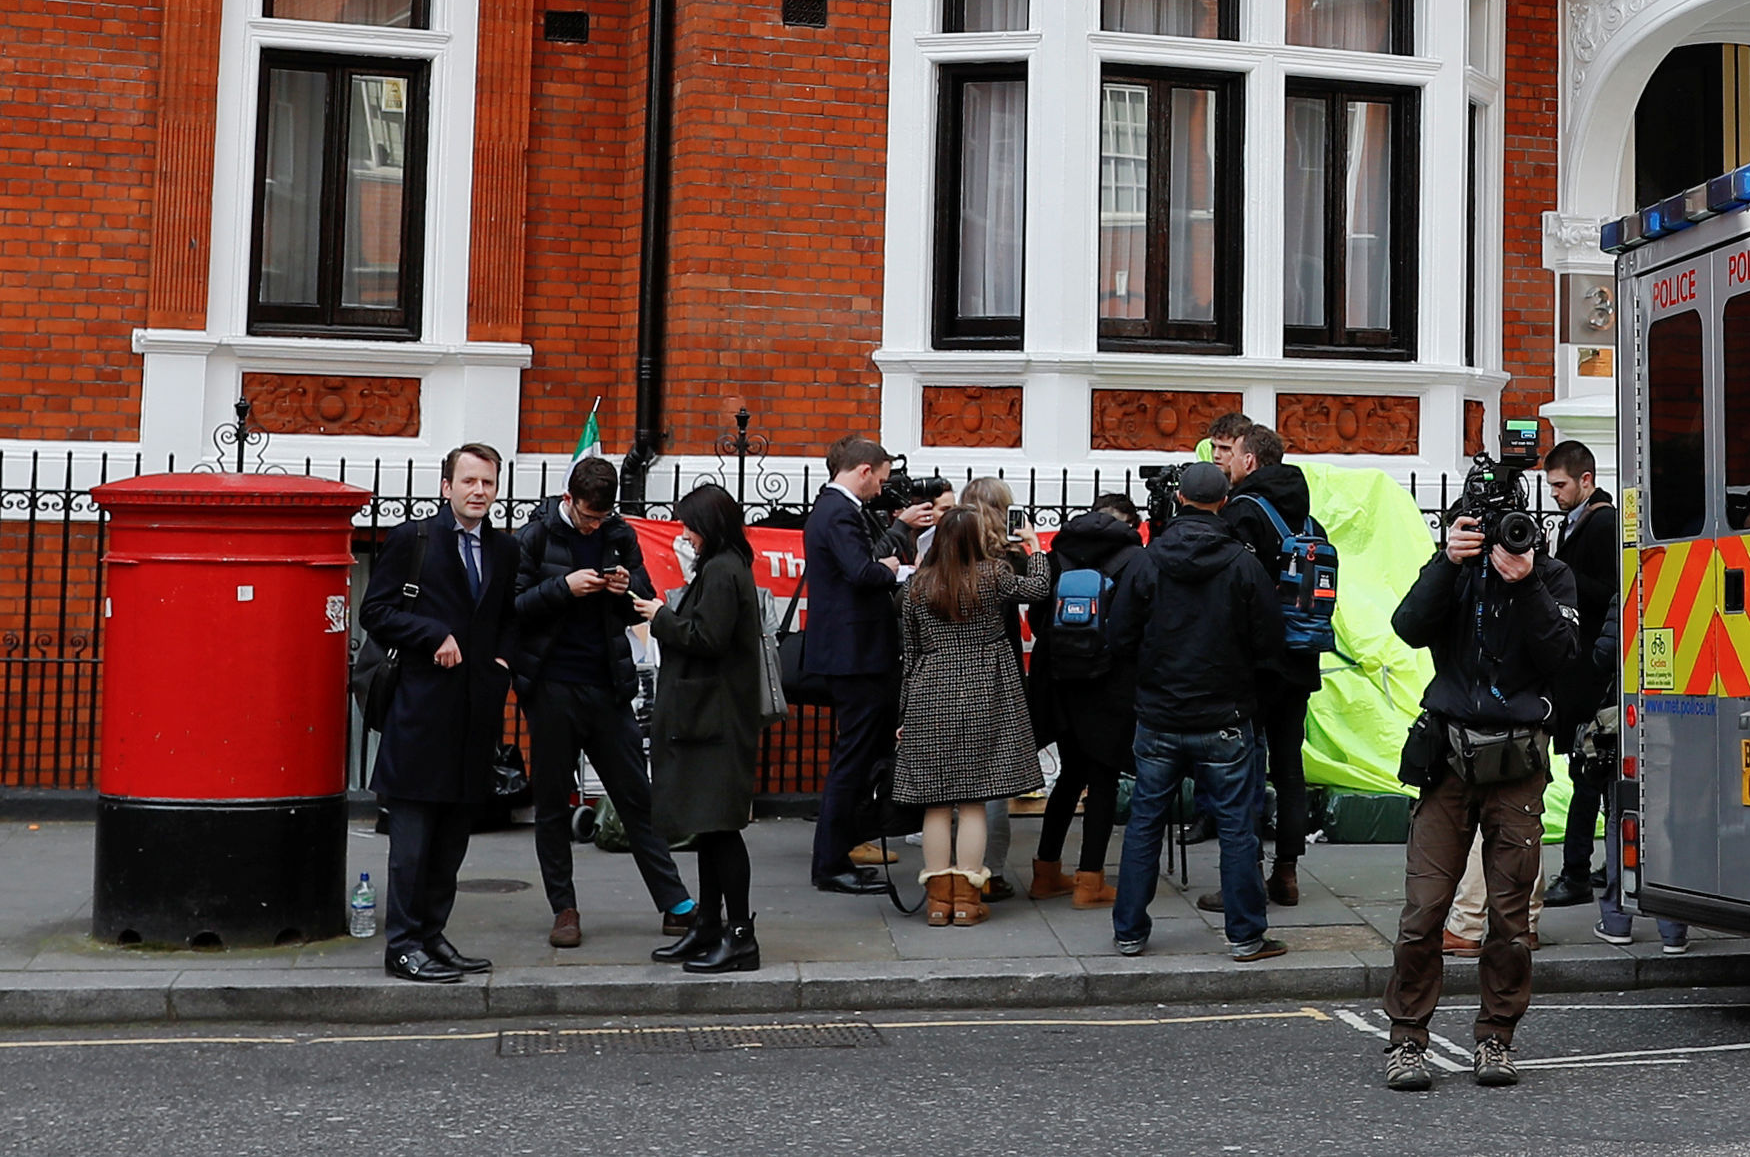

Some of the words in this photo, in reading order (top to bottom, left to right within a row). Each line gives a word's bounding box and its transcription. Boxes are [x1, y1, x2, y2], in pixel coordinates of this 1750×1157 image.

[1652, 269, 1696, 312] POLICE
[1585, 286, 1616, 331] 3
[761, 550, 806, 578] Th
[1645, 698, 1717, 719] www.met.police.uk
